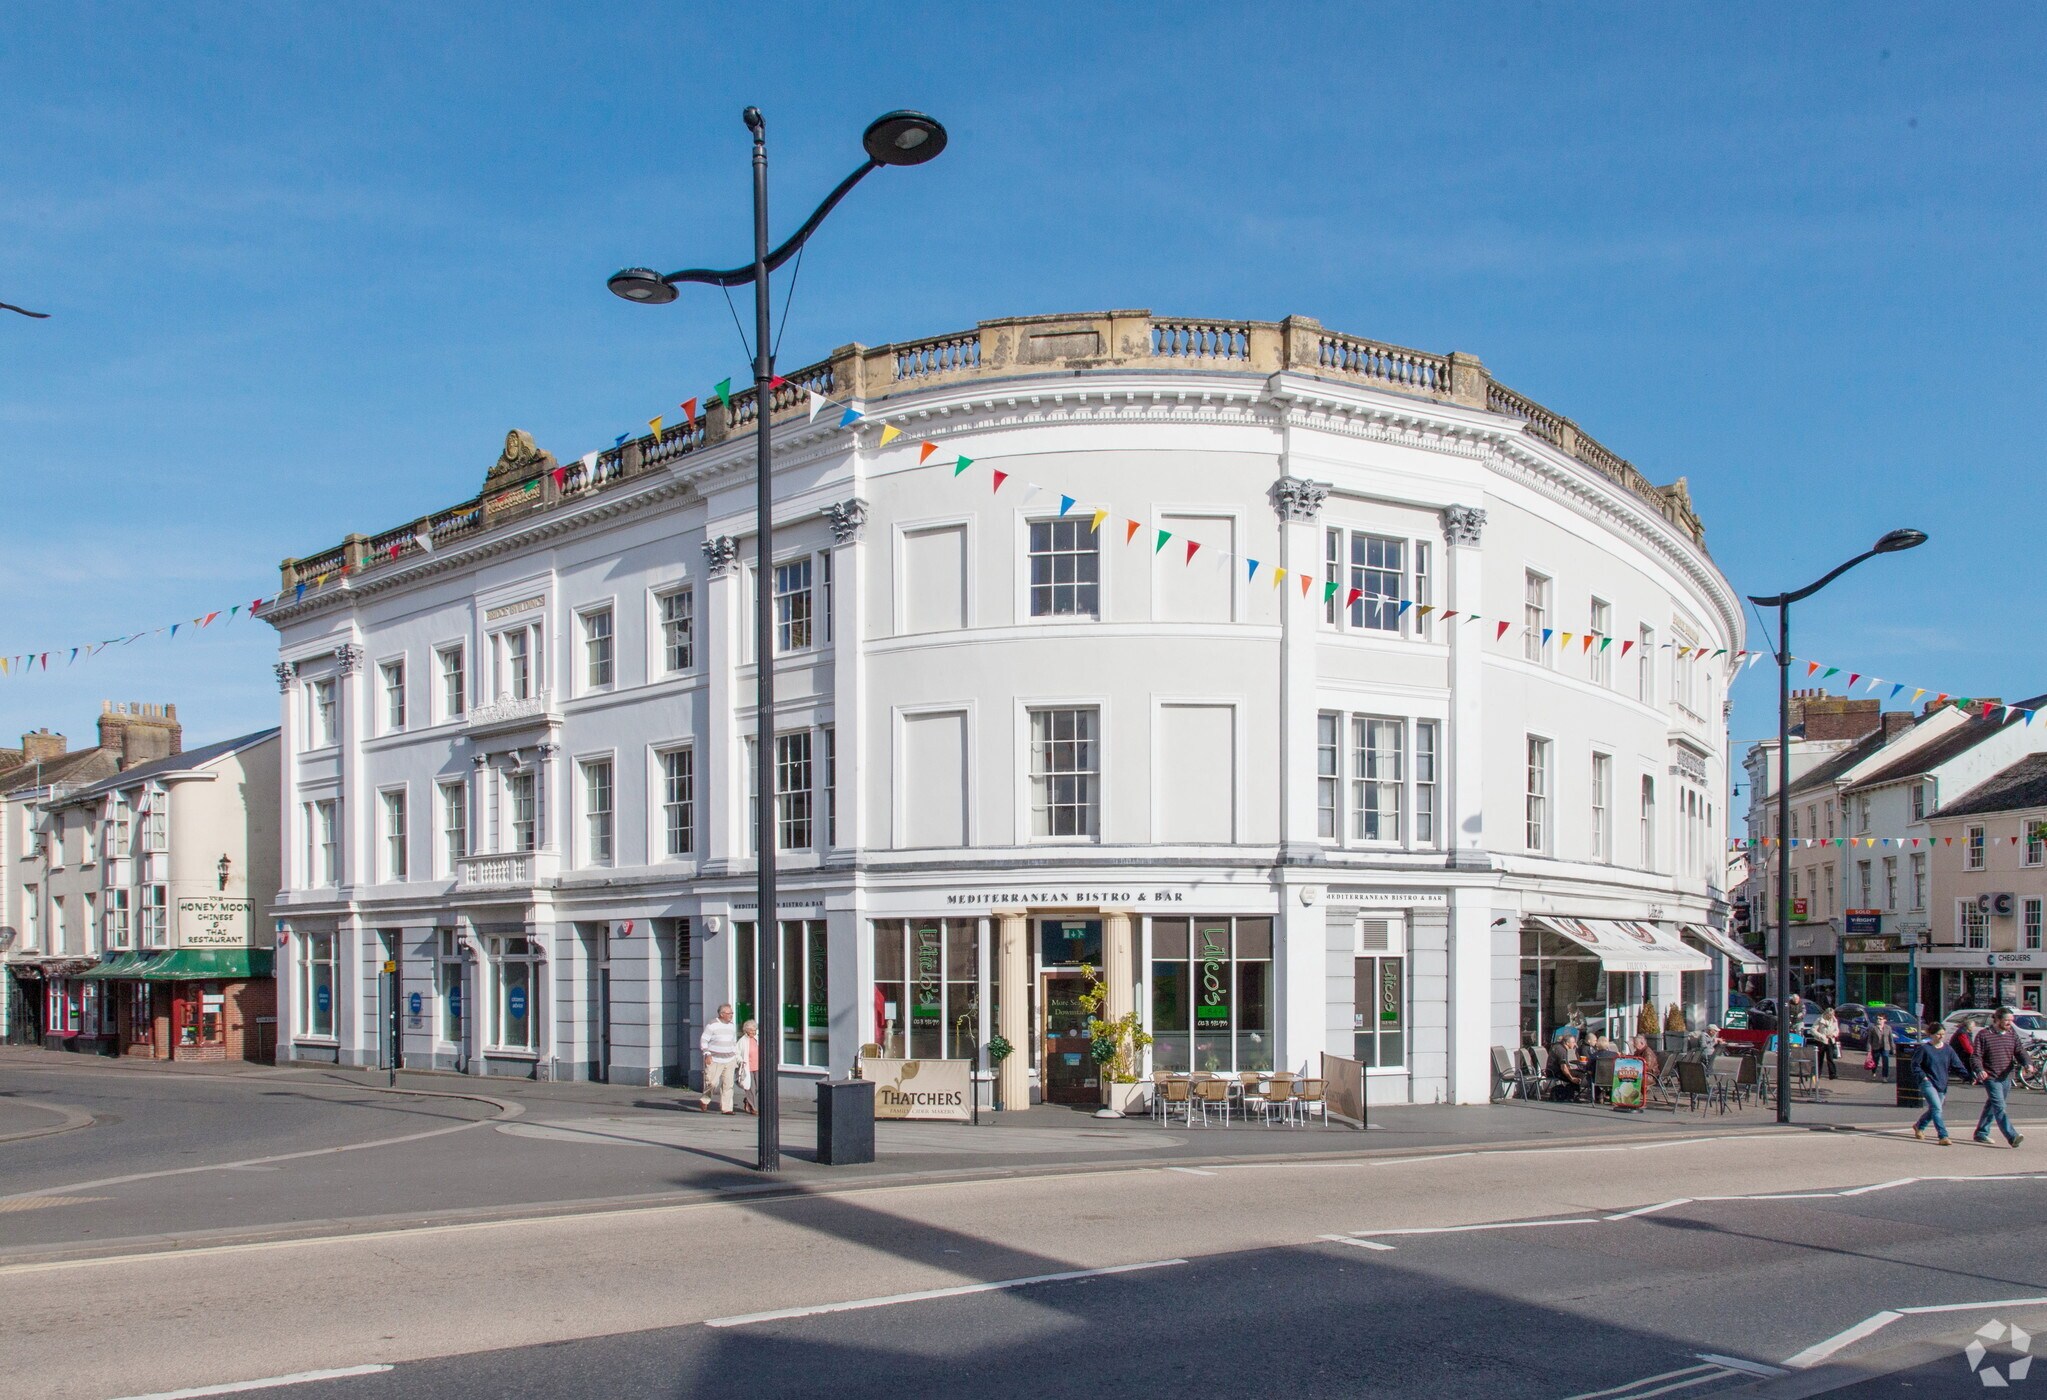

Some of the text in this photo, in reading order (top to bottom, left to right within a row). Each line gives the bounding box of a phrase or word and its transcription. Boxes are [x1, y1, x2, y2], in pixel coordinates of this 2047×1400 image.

[947, 892, 1183, 904] MEDITERRANEAN BISTRO & BAR
[180, 903, 251, 912] HONEY MOON
[882, 1090, 962, 1106] THATCHERS
